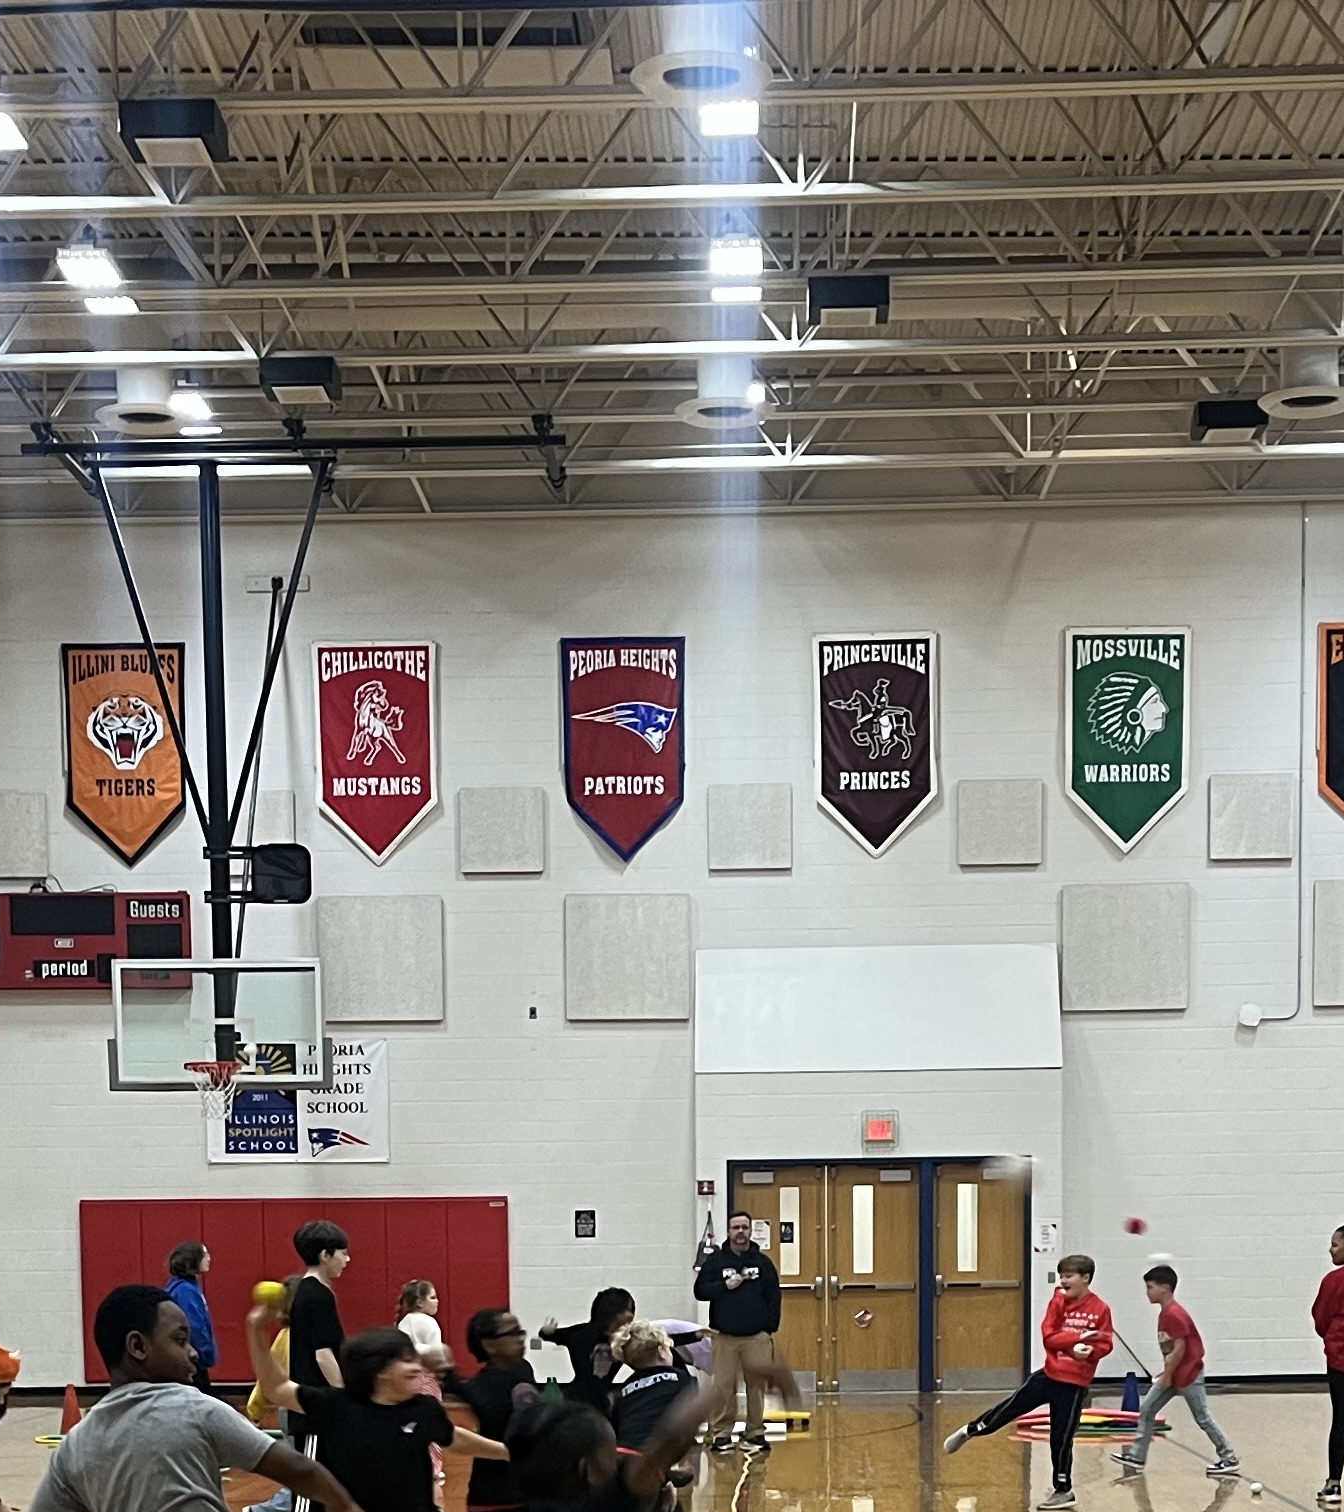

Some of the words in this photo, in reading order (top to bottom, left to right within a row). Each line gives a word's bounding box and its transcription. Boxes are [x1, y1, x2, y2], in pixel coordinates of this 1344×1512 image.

[823, 643, 926, 676] PRINCEVILLE
[1076, 638, 1180, 670] MOSSVILLE
[72, 654, 115, 684] ILLINI
[121, 653, 175, 684] BLUFS
[321, 650, 426, 682] CHILLICOTHE
[569, 650, 616, 681] PEORIA
[620, 648, 677, 680] HEIGHTS
[839, 770, 911, 790] PRINCES
[1084, 763, 1171, 783] WARRIORS
[96, 778, 156, 796] TIGERS
[332, 776, 422, 797] MUSTANGS
[584, 776, 665, 796] PATRIOTS
[130, 901, 180, 918] Guests
[42, 960, 88, 979] period
[308, 1044, 365, 1056] PRIA
[303, 1063, 372, 1075] HGHTS
[306, 1101, 369, 1114] SCHOOL
[229, 1114, 295, 1124] ILLINOIS
[228, 1127, 296, 1138] SPOTLIGHT
[229, 1141, 296, 1151] SCHOOL
